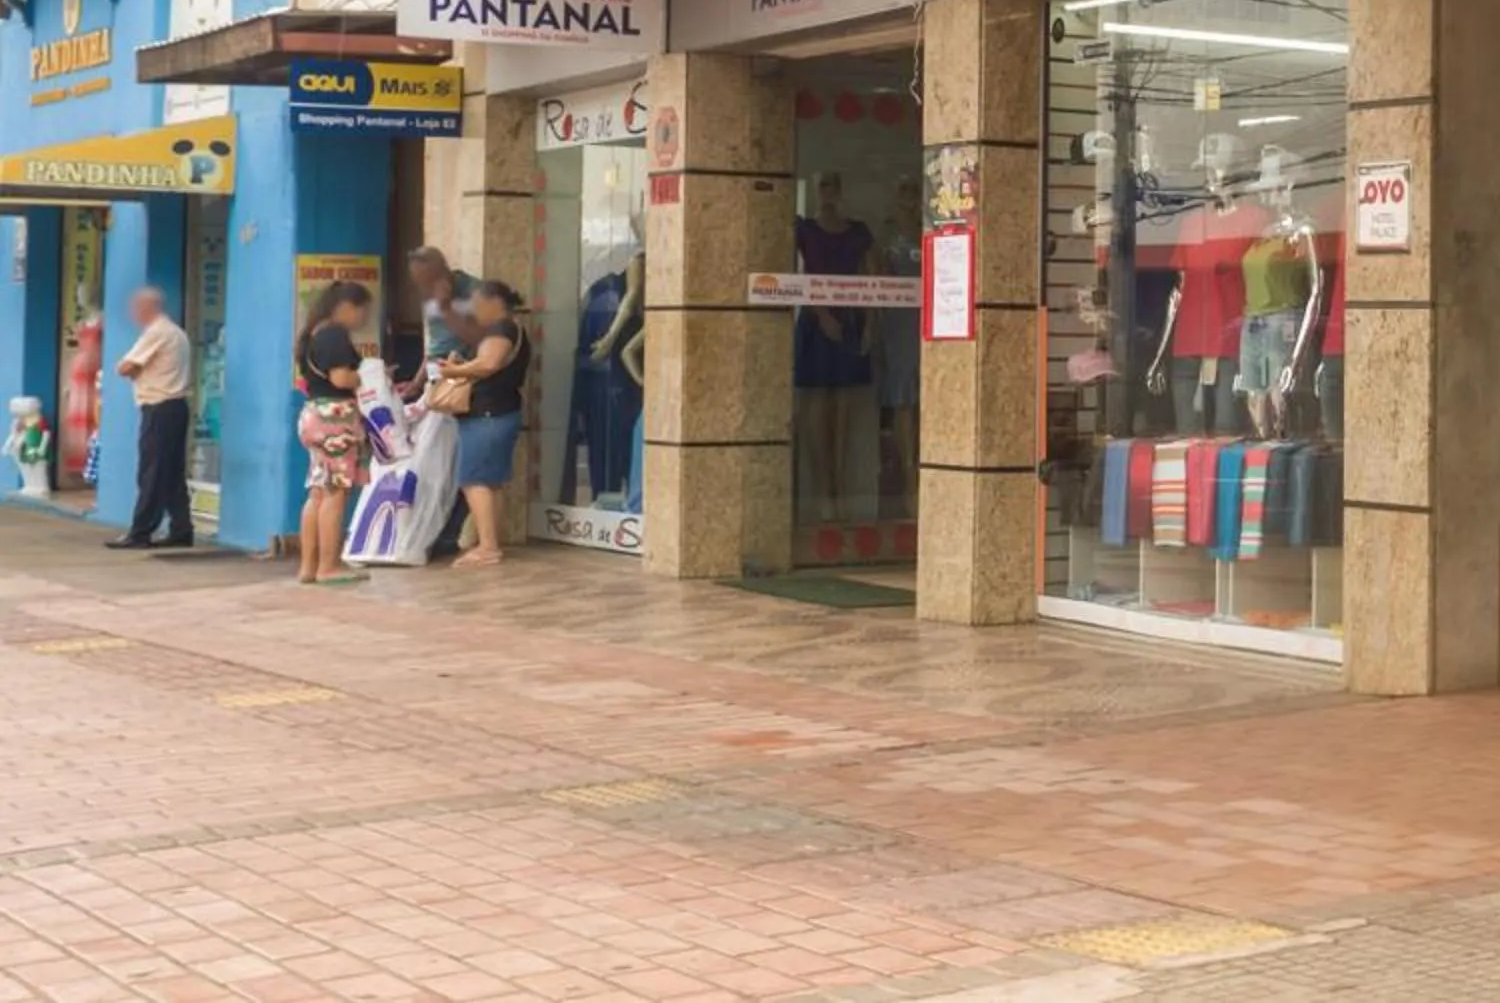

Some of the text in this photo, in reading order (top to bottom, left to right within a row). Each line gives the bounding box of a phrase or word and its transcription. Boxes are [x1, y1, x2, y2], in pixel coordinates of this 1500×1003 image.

[31, 28, 111, 81] PANDINHA
[298, 113, 354, 127] Shopping
[26, 159, 179, 187] PANDINHA
[1364, 179, 1404, 205] OYO
